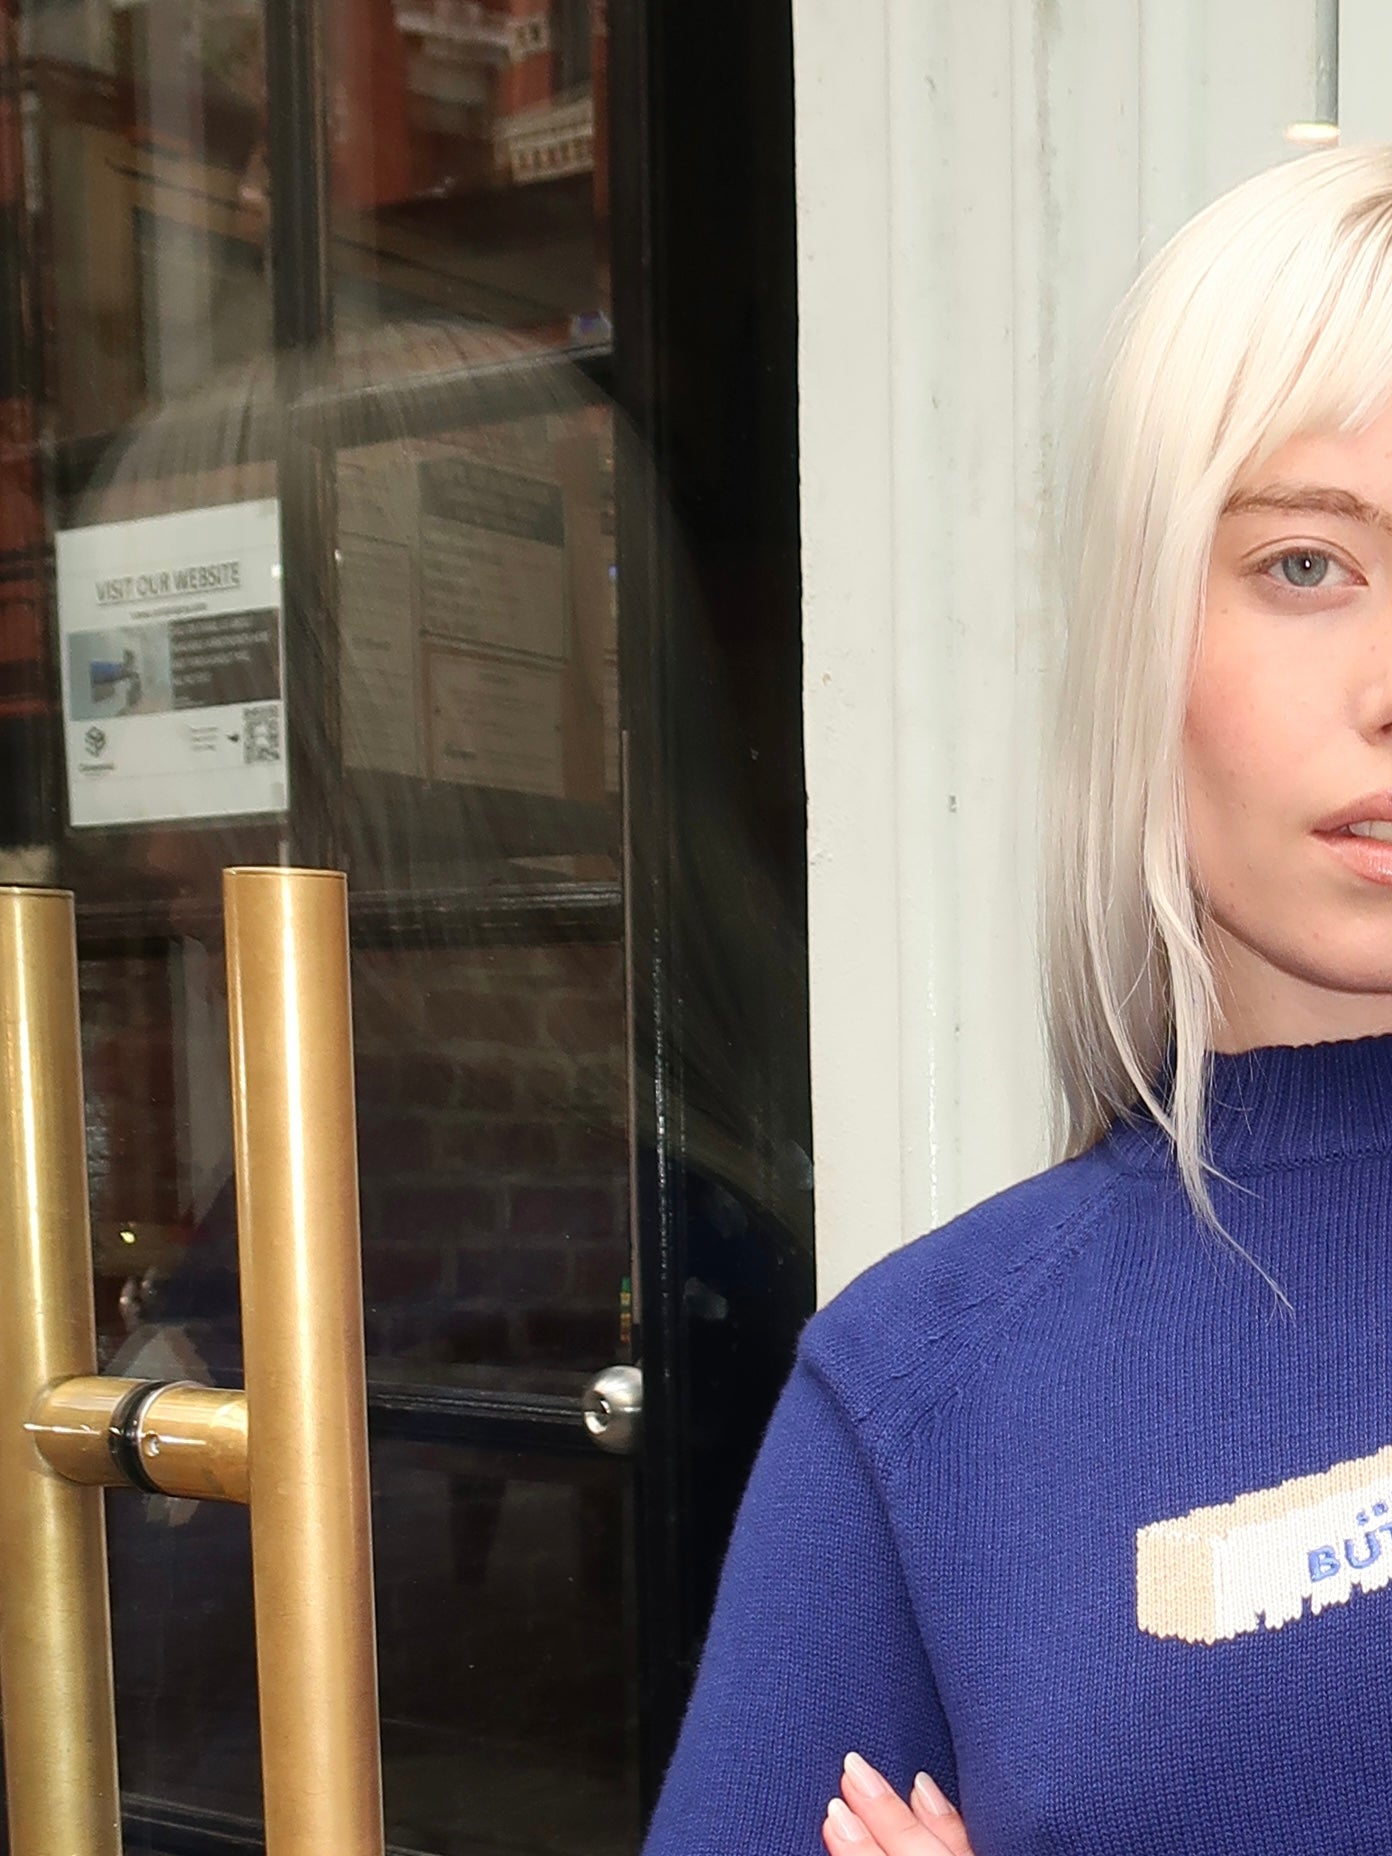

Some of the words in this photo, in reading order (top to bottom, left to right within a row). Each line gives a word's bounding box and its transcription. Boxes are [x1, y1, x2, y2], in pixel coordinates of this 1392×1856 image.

[95, 576, 133, 600] VISIT
[136, 571, 170, 596] OUR
[173, 561, 240, 591] WEBSITE
